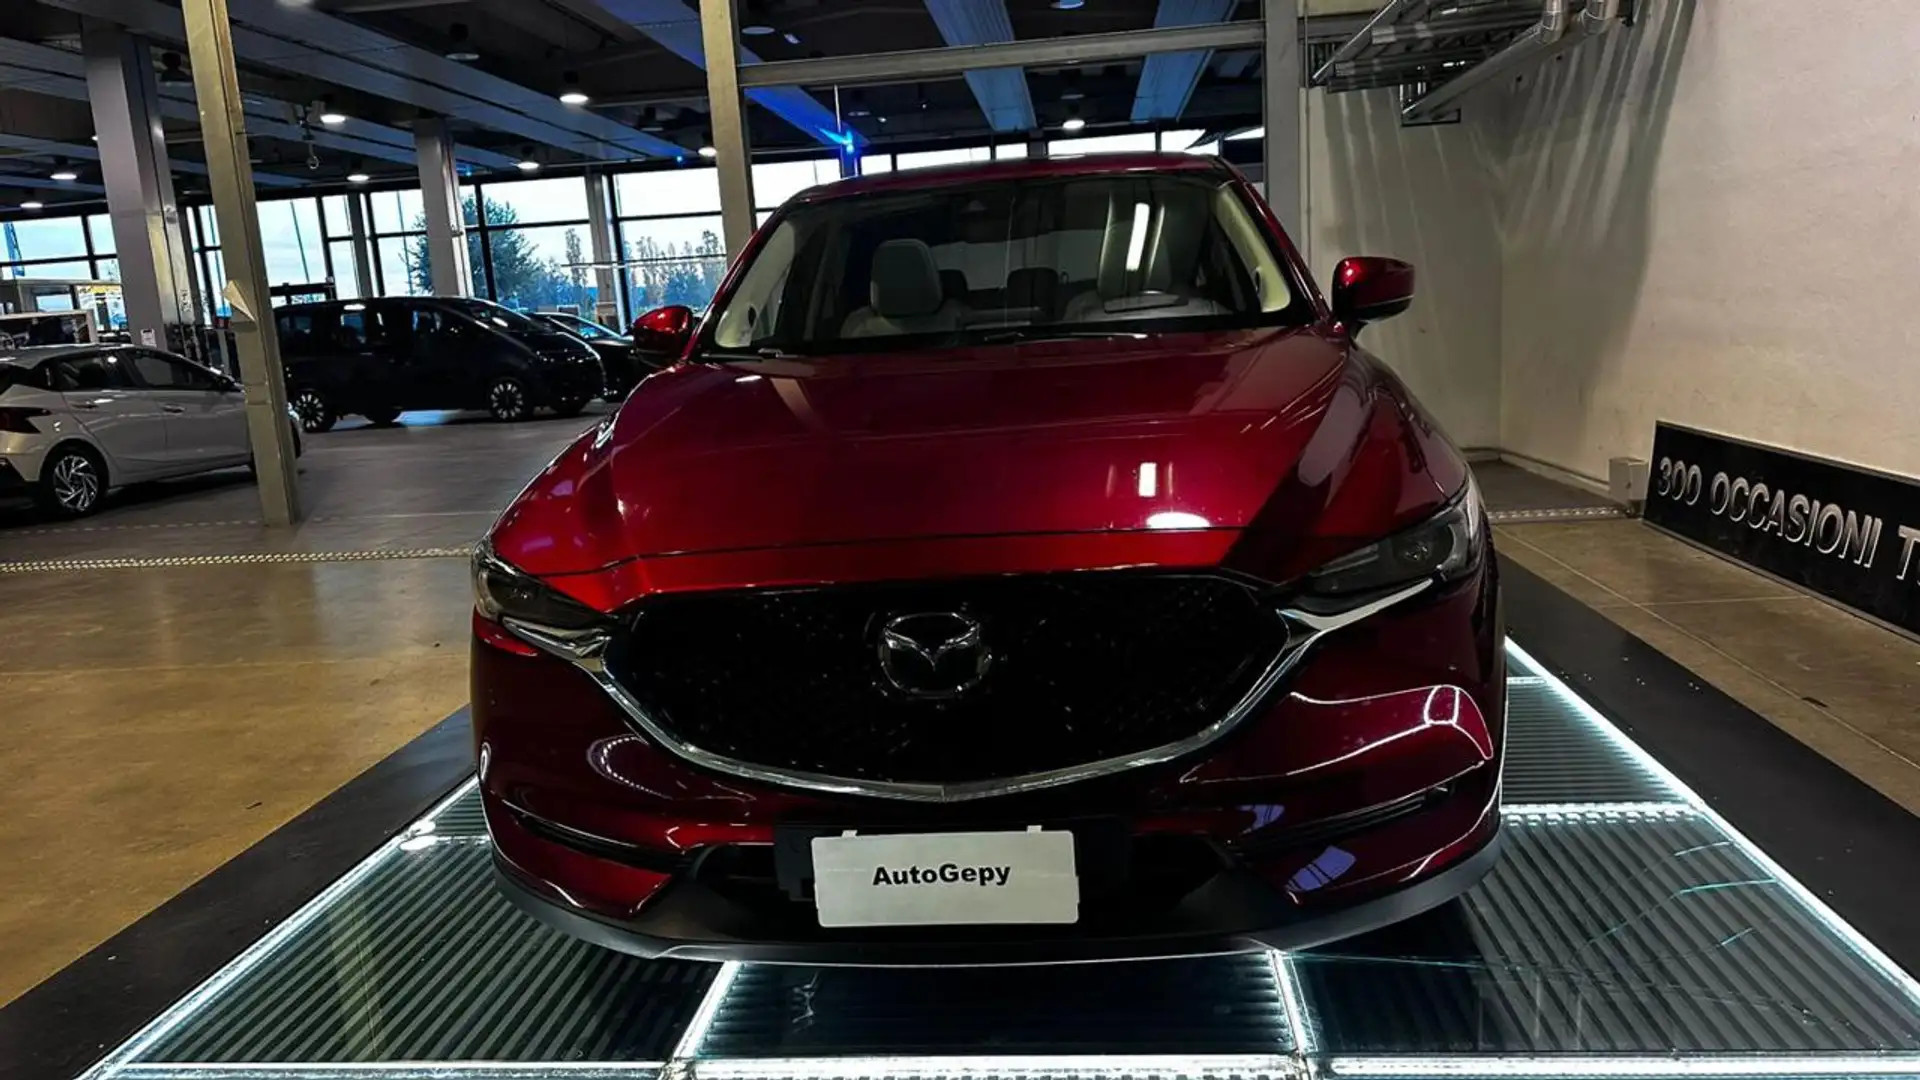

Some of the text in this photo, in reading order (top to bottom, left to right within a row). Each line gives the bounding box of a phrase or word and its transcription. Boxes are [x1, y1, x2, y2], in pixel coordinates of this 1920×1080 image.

[1658, 456, 1702, 506] 300
[1710, 472, 1883, 568] OCCASIONI
[873, 863, 1011, 886] AutoGepy
